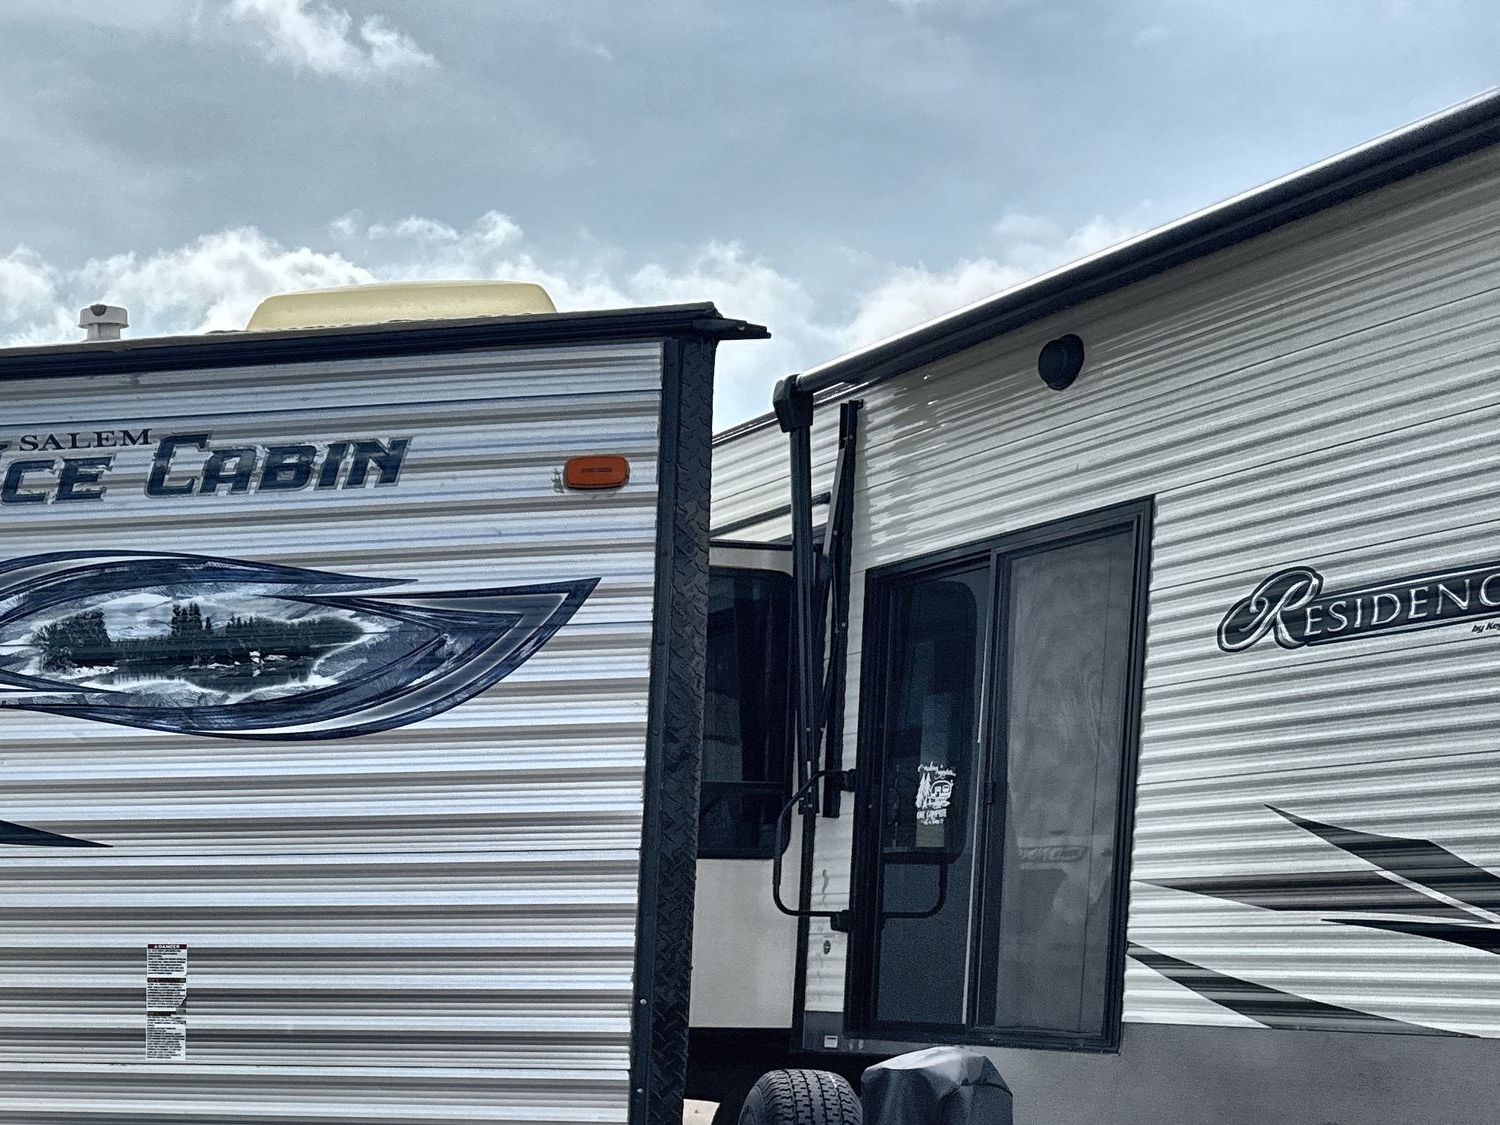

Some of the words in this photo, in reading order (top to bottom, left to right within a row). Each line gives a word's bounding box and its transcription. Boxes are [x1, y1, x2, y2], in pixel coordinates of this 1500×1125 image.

[18, 427, 153, 453] SALEM
[143, 430, 413, 499] CABIN
[1218, 566, 1500, 652] RESIDENC
[1471, 624, 1485, 634] by
